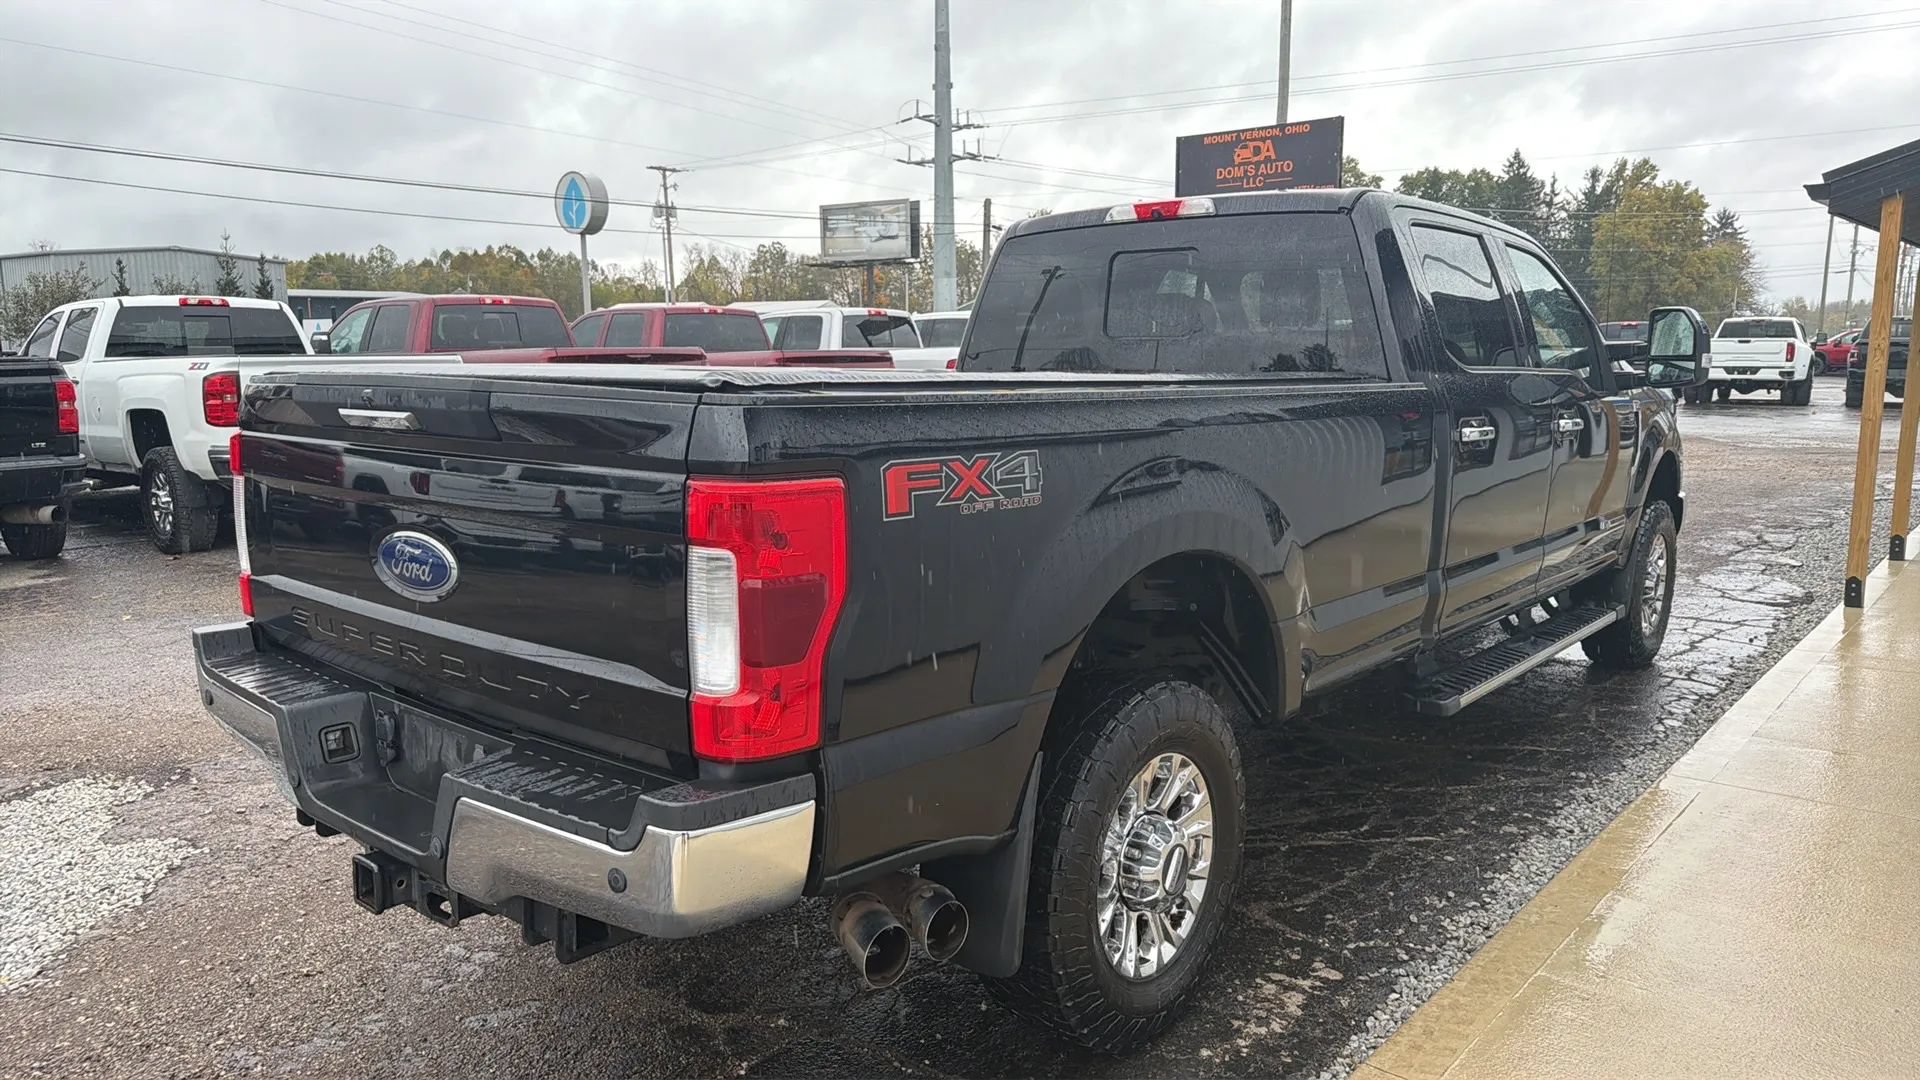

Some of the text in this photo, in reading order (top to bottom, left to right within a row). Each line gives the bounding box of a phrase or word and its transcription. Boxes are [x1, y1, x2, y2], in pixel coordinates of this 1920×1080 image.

[1203, 123, 1311, 145] MOUNT VERNON, OHIO
[1216, 160, 1294, 180] DOM'S AUTO
[1243, 176, 1265, 188] LLC
[880, 449, 1043, 521] FX4
[959, 495, 1043, 515] OFF ROAD
[391, 543, 433, 582] Ford
[291, 606, 427, 666] SUPER
